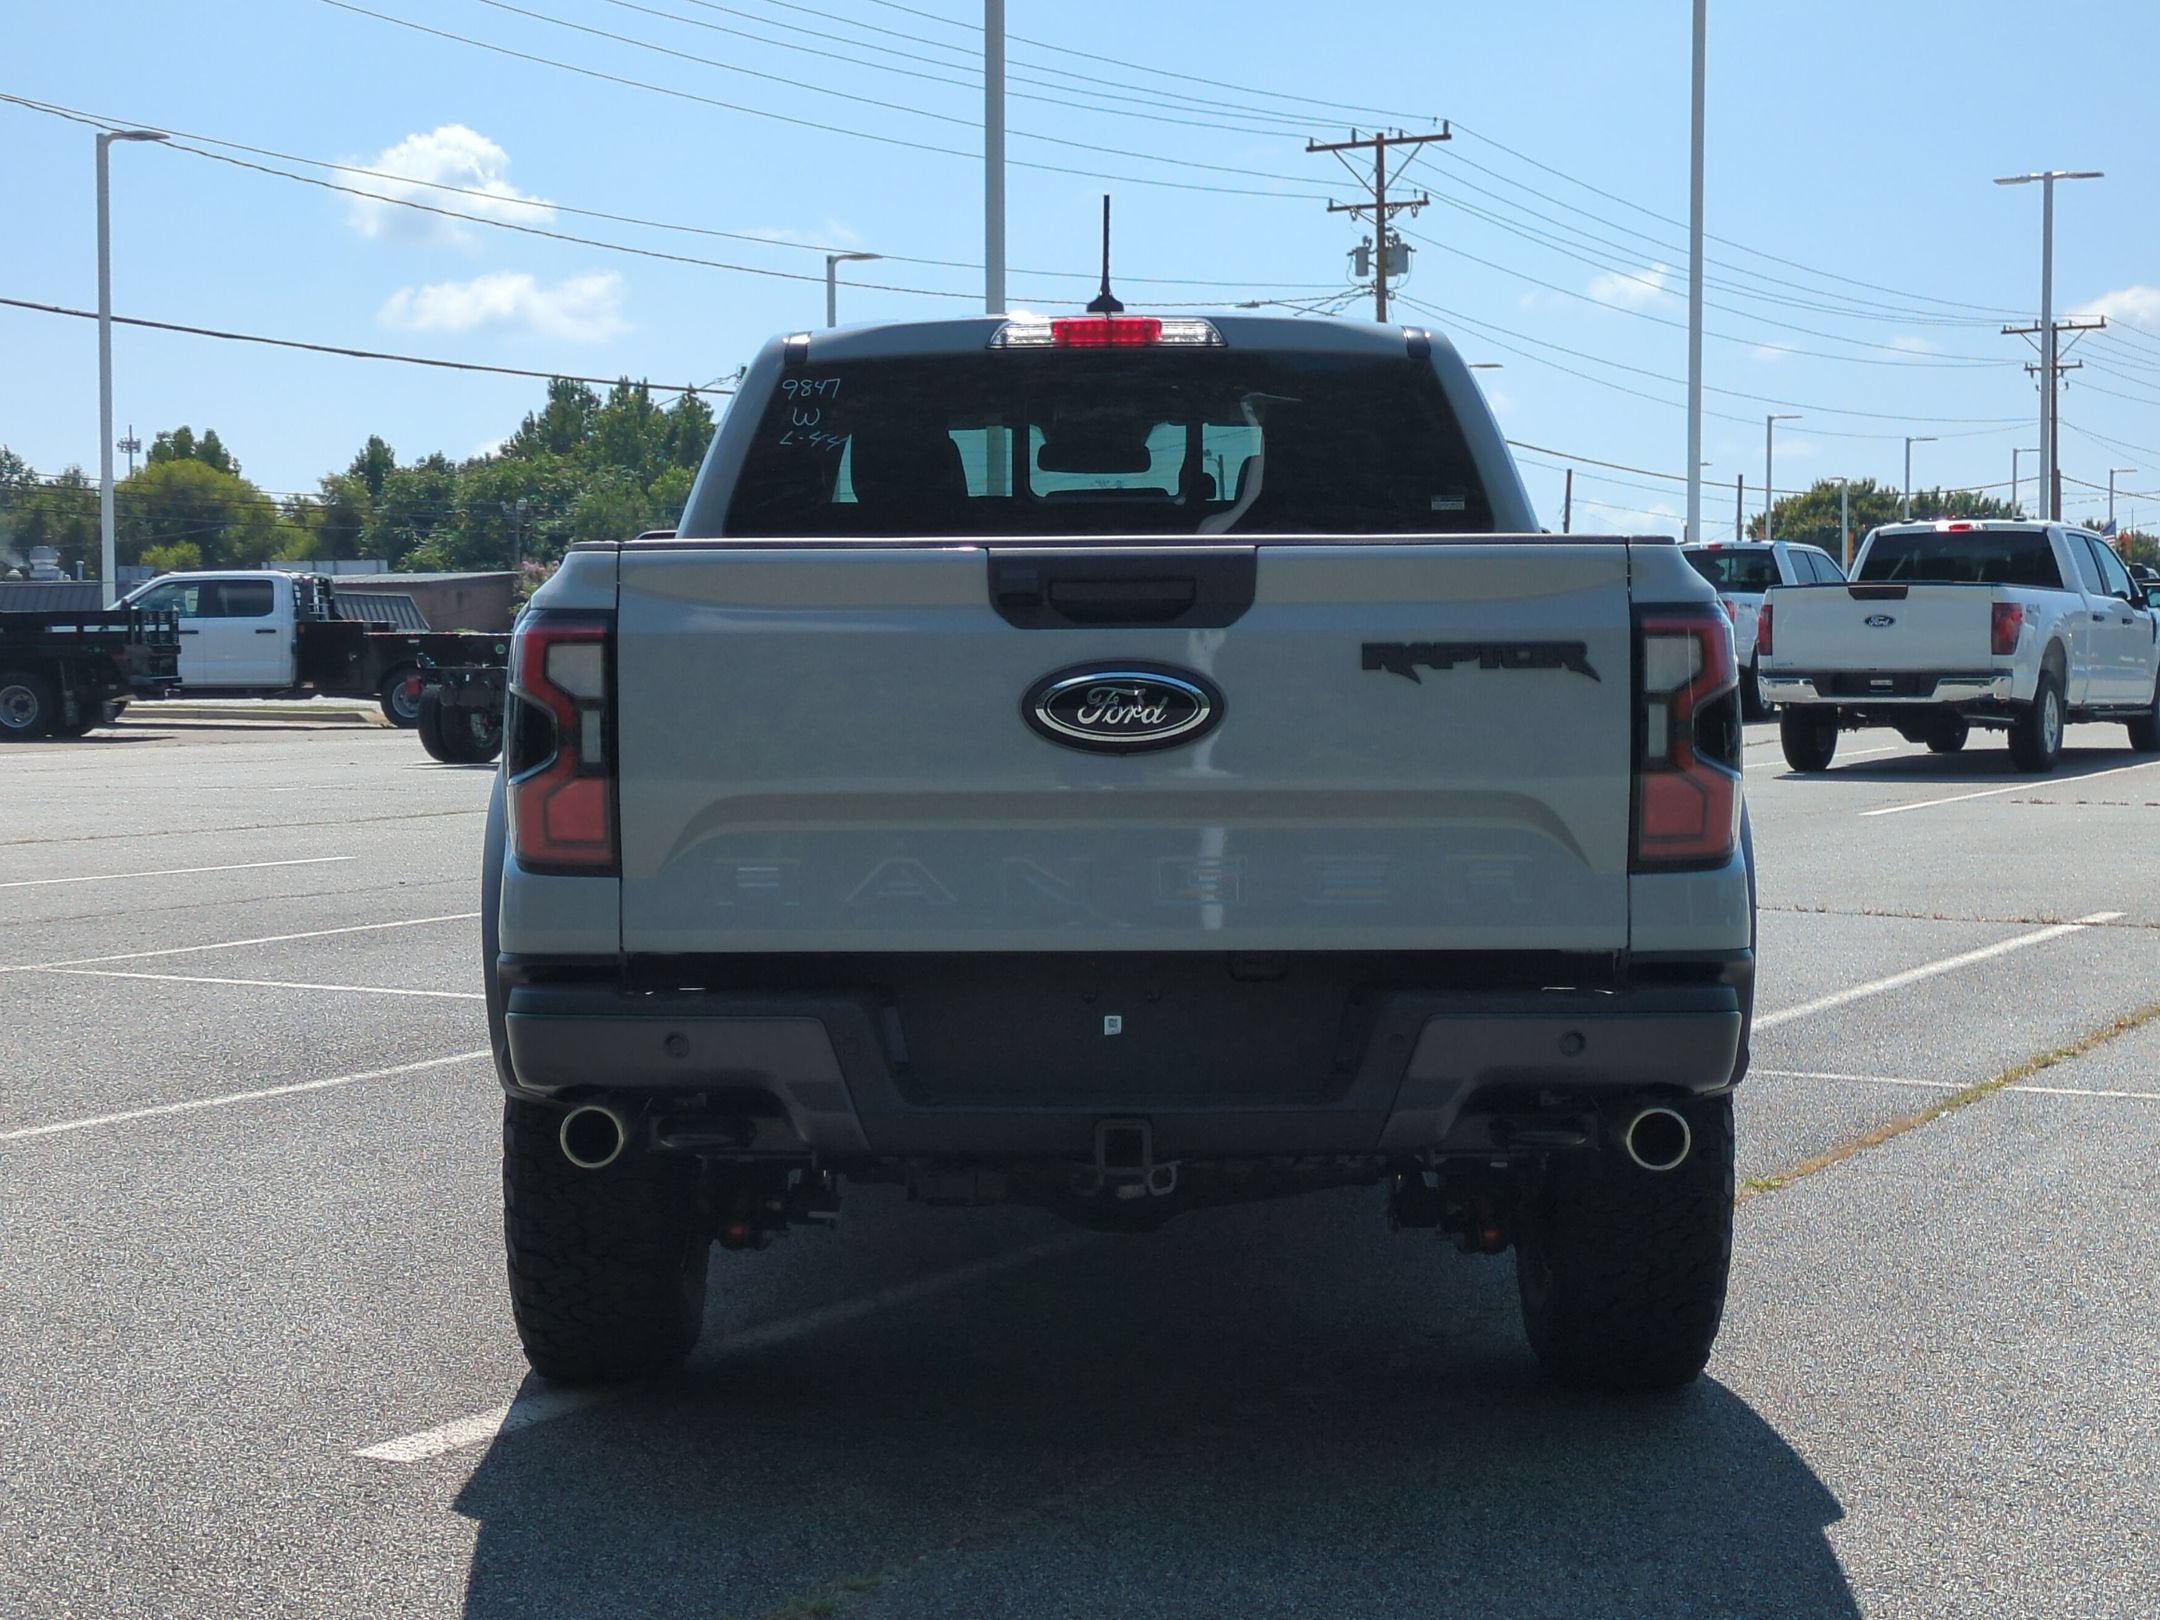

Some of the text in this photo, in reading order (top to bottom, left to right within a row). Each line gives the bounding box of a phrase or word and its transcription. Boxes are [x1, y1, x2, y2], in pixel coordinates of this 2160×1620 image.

[782, 377, 841, 400] 9847
[1362, 641, 1602, 685] RAPTOR
[1077, 685, 1169, 726] Ford
[714, 856, 1533, 906] RANGER
